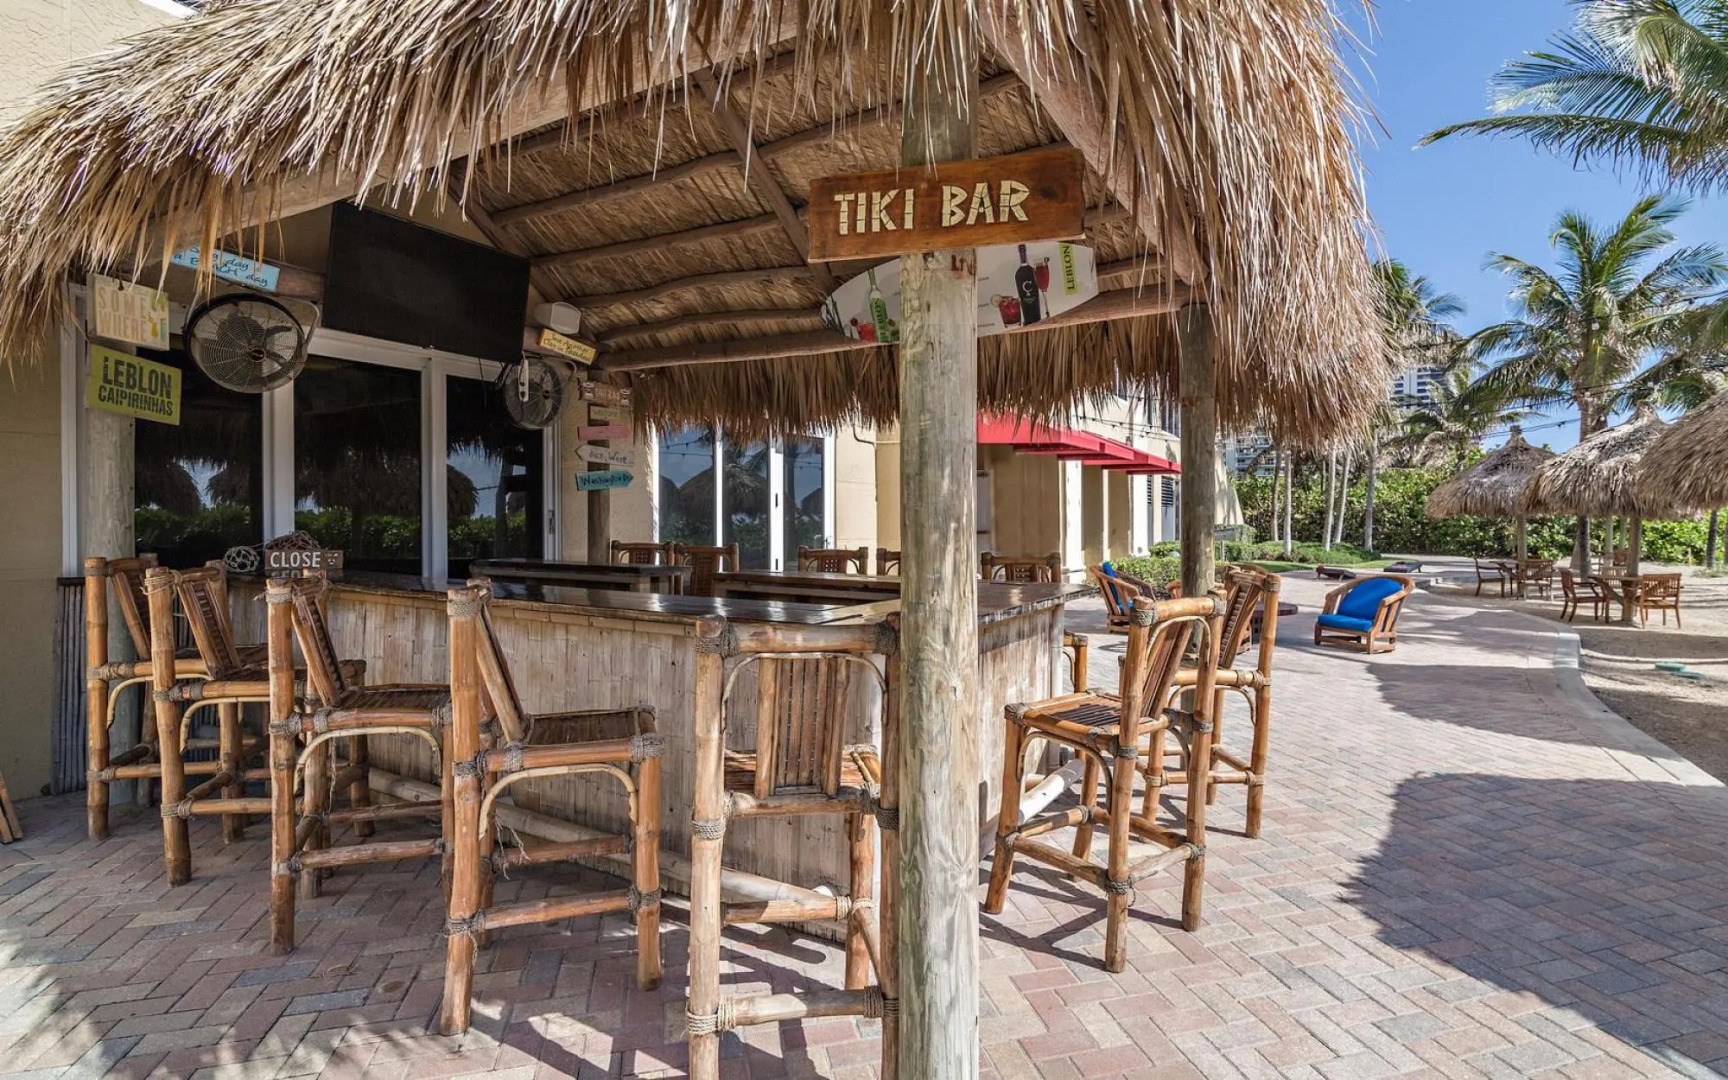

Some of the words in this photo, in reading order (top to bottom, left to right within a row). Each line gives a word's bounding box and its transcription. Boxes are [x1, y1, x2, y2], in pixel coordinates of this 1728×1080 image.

[834, 188, 914, 236] TIKI
[941, 180, 1030, 228] BAR
[1063, 245, 1076, 290] LEBLON
[97, 288, 147, 320] SOME
[98, 311, 147, 342] WHERE
[102, 356, 172, 399] LEBLON
[98, 385, 173, 416] CAIPIRINHAS
[270, 551, 321, 568] CLOSE
